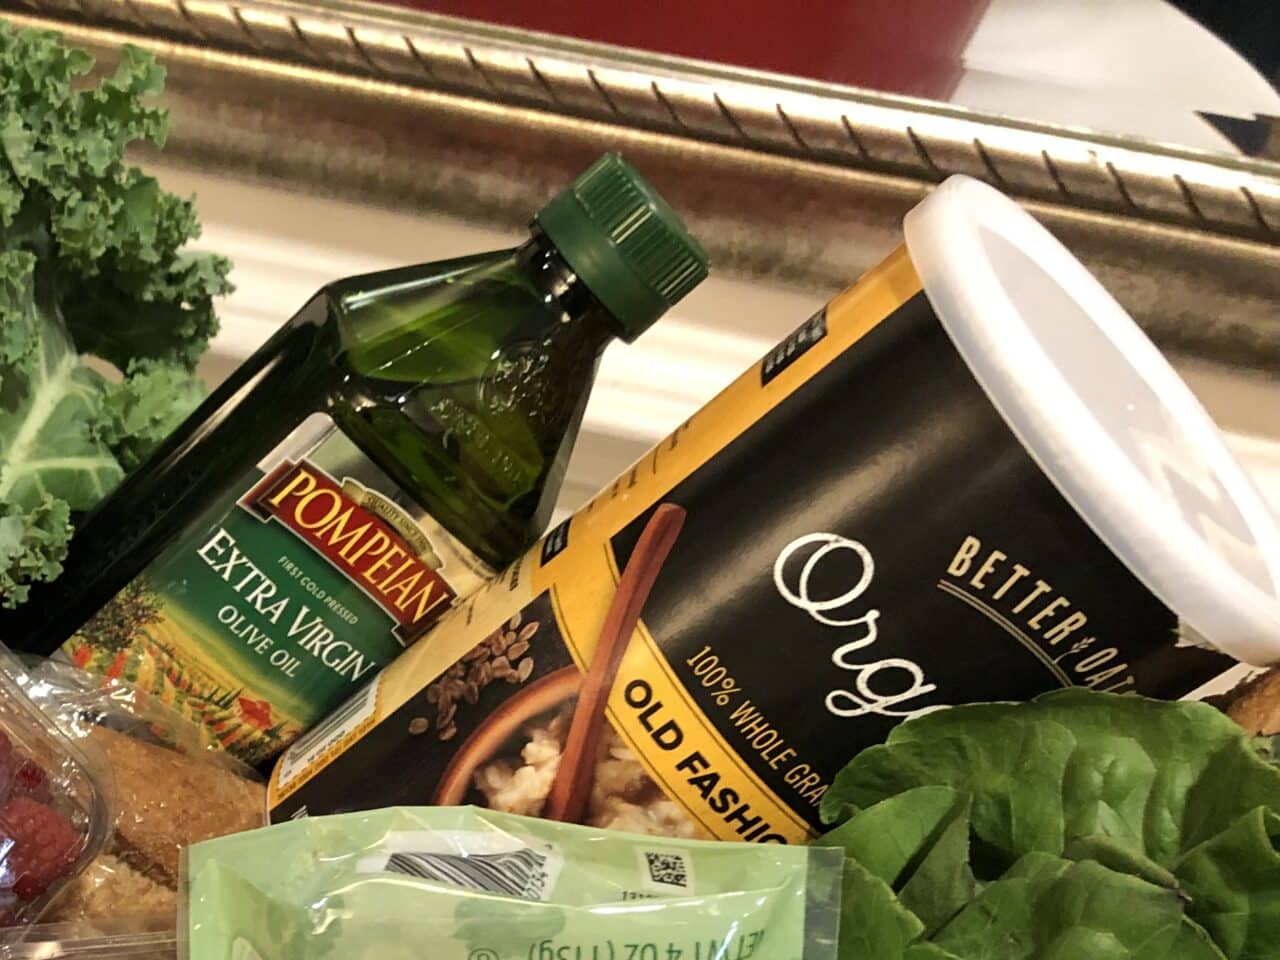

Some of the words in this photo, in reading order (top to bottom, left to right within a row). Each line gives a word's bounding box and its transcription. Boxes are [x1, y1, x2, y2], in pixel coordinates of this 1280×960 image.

[197, 527, 290, 624] EXTRA
[287, 605, 376, 682] VIRGIN
[271, 469, 449, 624] POMPEIAN
[277, 555, 303, 579] FIRST
[299, 576, 326, 599] COLD
[323, 595, 359, 625] PRESSED
[947, 535, 1087, 645] BETTER
[1074, 647, 1135, 694] OAT
[217, 604, 274, 655] OLIVE
[269, 649, 302, 678] OIL
[773, 532, 952, 718] Org
[623, 679, 684, 751] OLD
[686, 645, 743, 706] 100%
[729, 699, 798, 771] WHOLE
[783, 763, 830, 808] GRA
